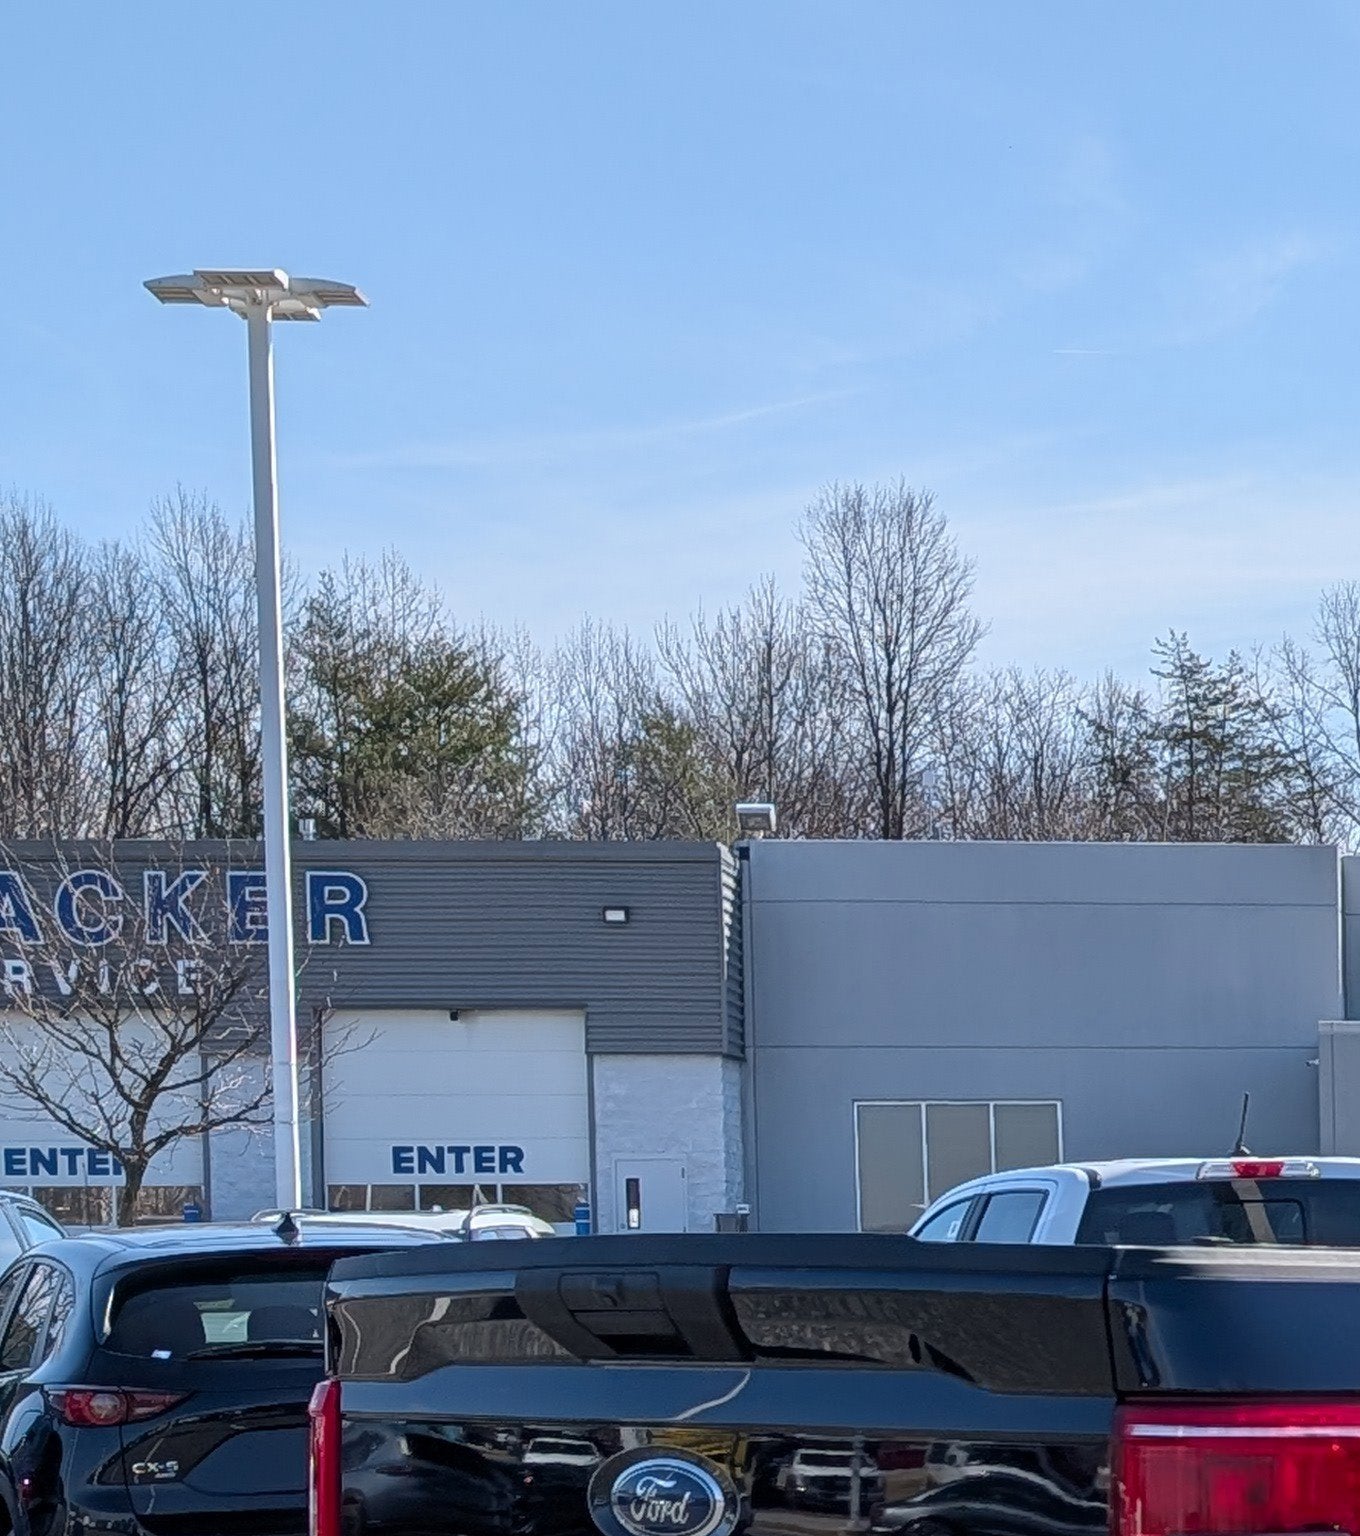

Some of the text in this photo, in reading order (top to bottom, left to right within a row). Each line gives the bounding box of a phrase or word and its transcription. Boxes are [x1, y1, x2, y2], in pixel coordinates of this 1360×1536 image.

[392, 1146, 525, 1174] ENTER
[132, 1461, 179, 1474] CX-5
[630, 1476, 691, 1525] Ford
